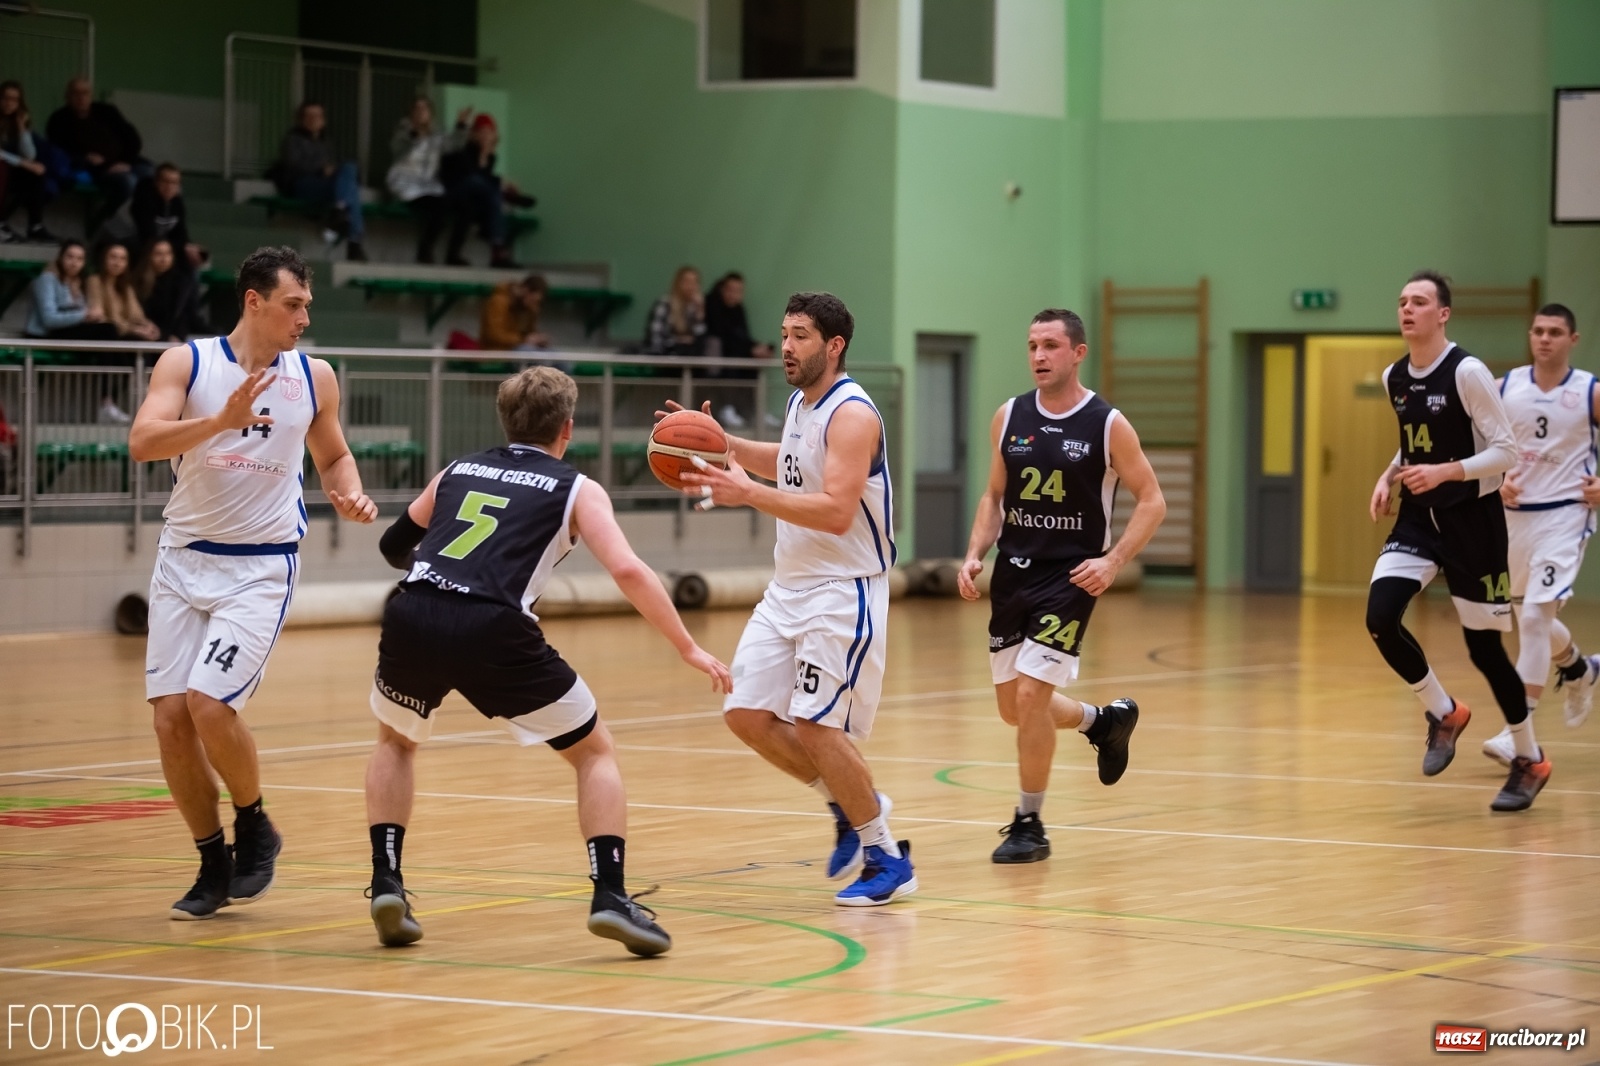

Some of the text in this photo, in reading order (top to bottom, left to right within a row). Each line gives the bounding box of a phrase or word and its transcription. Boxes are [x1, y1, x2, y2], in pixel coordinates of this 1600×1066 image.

[241, 407, 272, 438] 4
[1403, 423, 1433, 453] 14
[1535, 416, 1548, 439] 3
[1062, 440, 1090, 455] STELA
[229, 460, 279, 474] KAMPKA
[451, 462, 559, 493] NACOMI CIESZYN
[784, 454, 803, 487] 35
[1020, 466, 1066, 502] 24
[438, 490, 511, 560] 5
[1011, 507, 1083, 531] Nacomi
[1479, 571, 1511, 602] 14
[1542, 566, 1556, 587] 3
[1033, 614, 1081, 651] 24
[203, 638, 239, 673] 14
